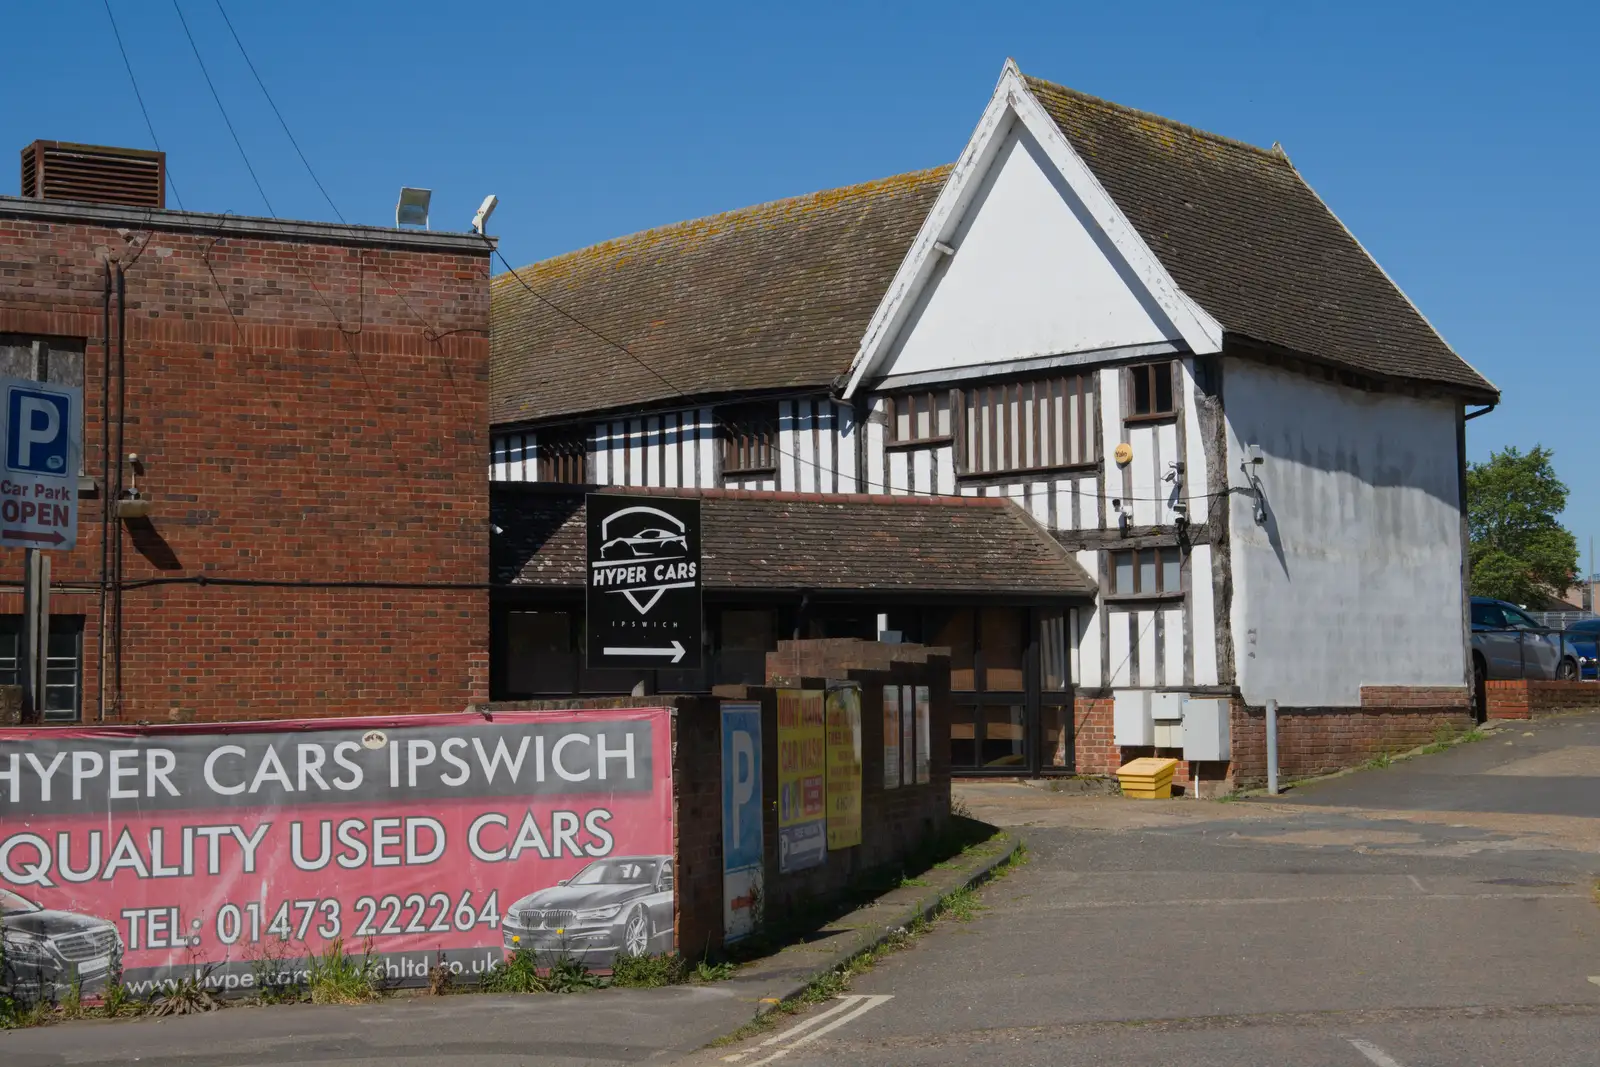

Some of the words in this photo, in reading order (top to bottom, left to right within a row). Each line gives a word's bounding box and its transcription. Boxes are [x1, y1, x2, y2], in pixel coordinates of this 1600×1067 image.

[18, 396, 60, 467] P
[0, 480, 28, 497] Car
[35, 483, 71, 501] Park
[2, 499, 69, 528] OPEN
[593, 566, 647, 586] HYPER
[653, 562, 697, 581] CARS
[612, 620, 678, 628] IPSWICH
[203, 743, 363, 795] CARS
[390, 732, 635, 788] IPSWICH
[732, 730, 755, 849] P
[0, 823, 272, 887] QUALITY
[290, 815, 446, 871] USED
[468, 807, 614, 862] CARS
[121, 906, 202, 951] TEL:
[216, 897, 341, 945] 01473
[354, 889, 501, 937] 222264
